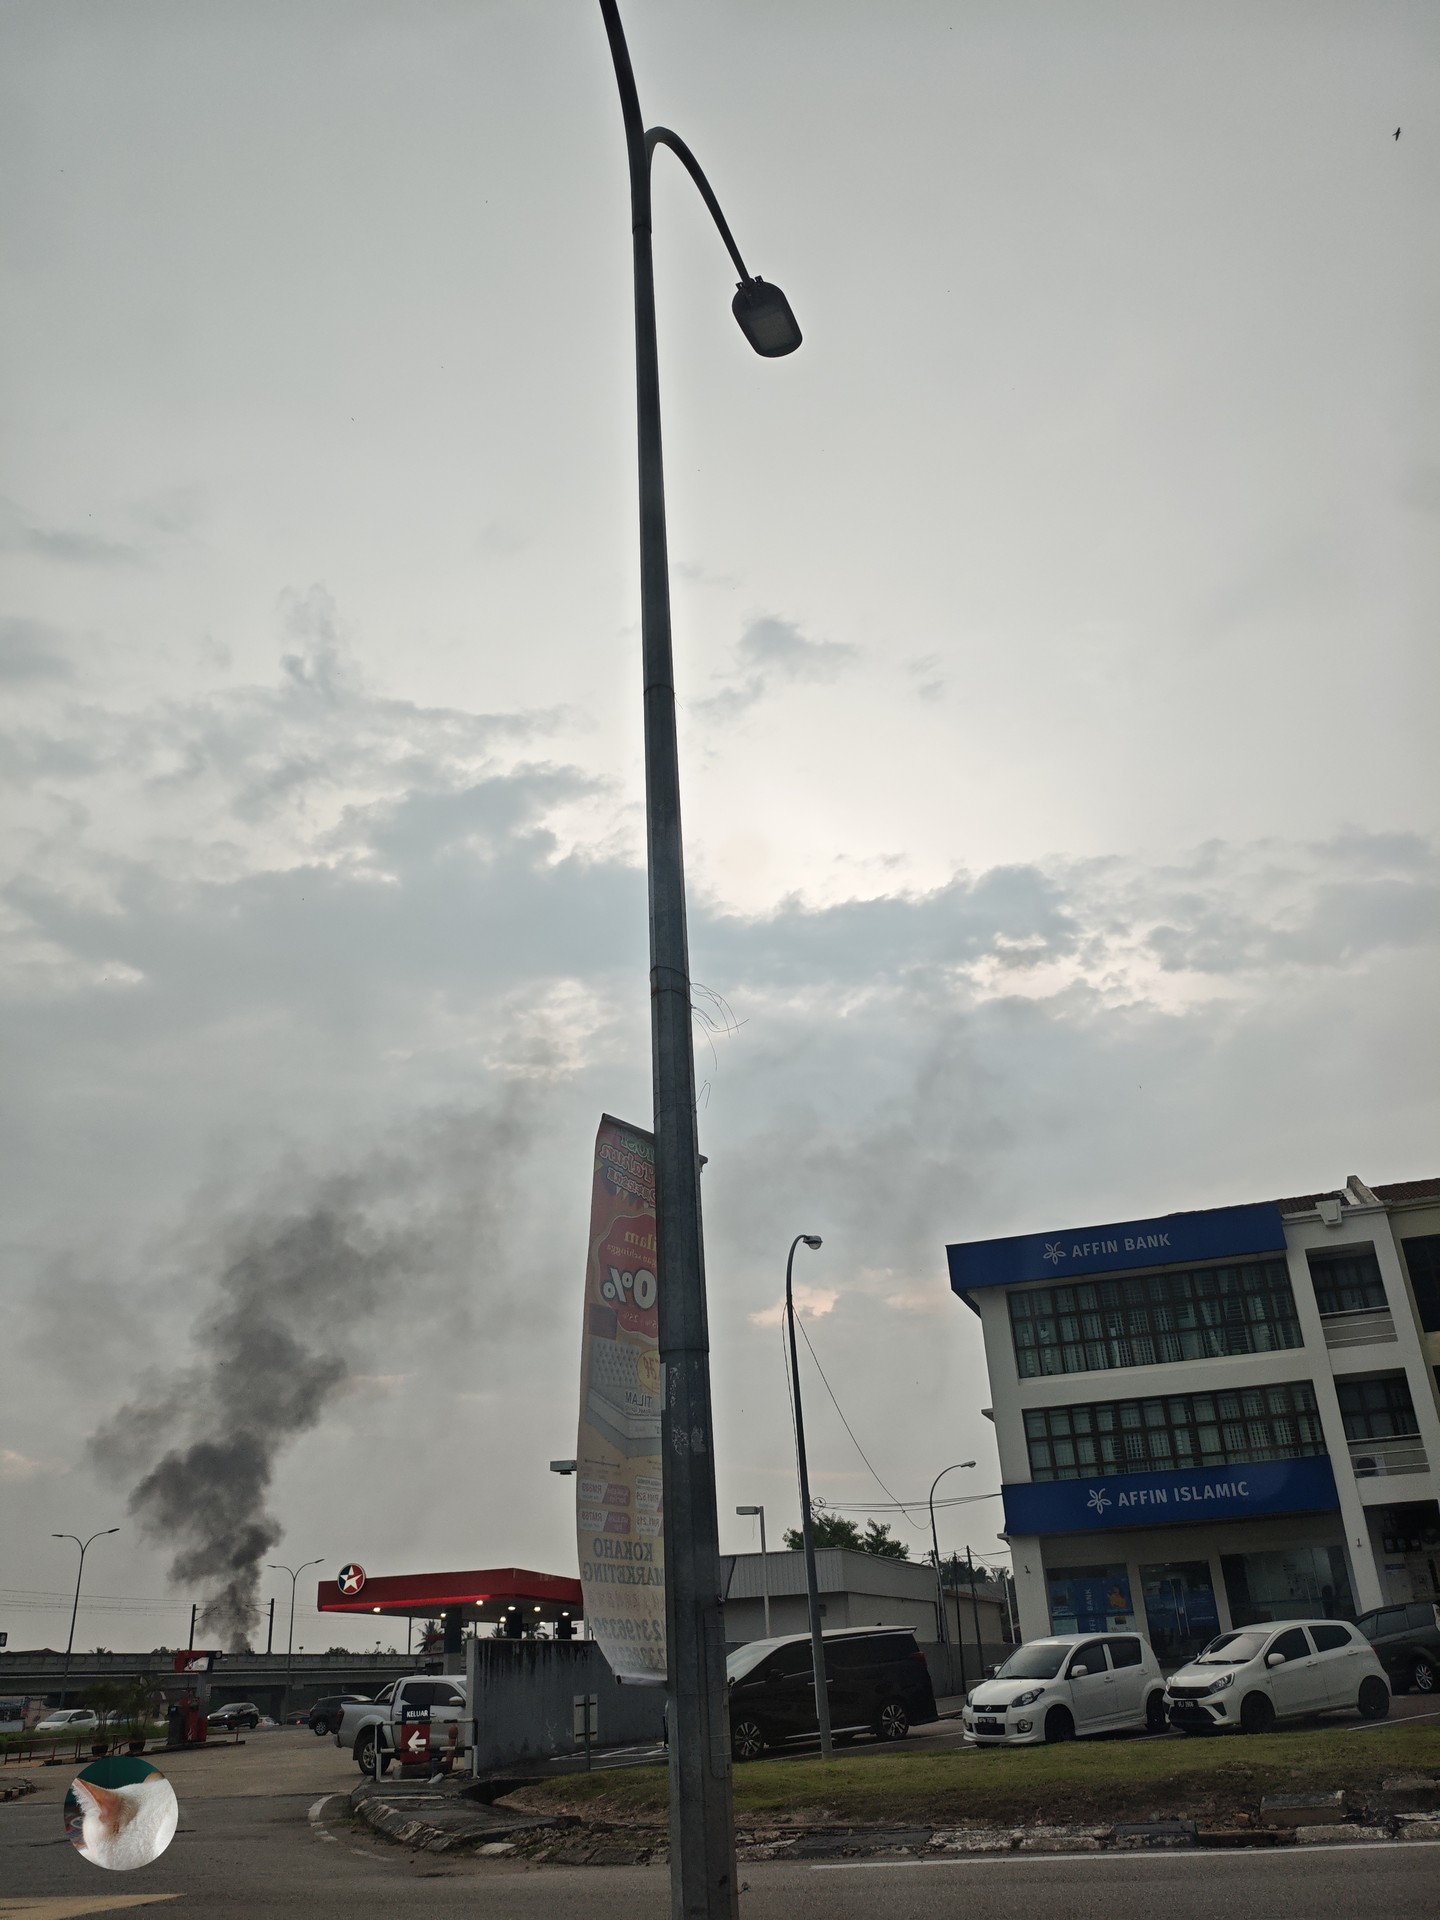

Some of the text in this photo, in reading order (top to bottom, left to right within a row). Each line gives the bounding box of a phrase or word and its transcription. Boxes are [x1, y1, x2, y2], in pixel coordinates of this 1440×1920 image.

[1072, 1233, 1171, 1258] AFFIN BANK
[1118, 1481, 1250, 1507] AFFIN ISLAMIC
[406, 1709, 429, 1718] KELUAR
